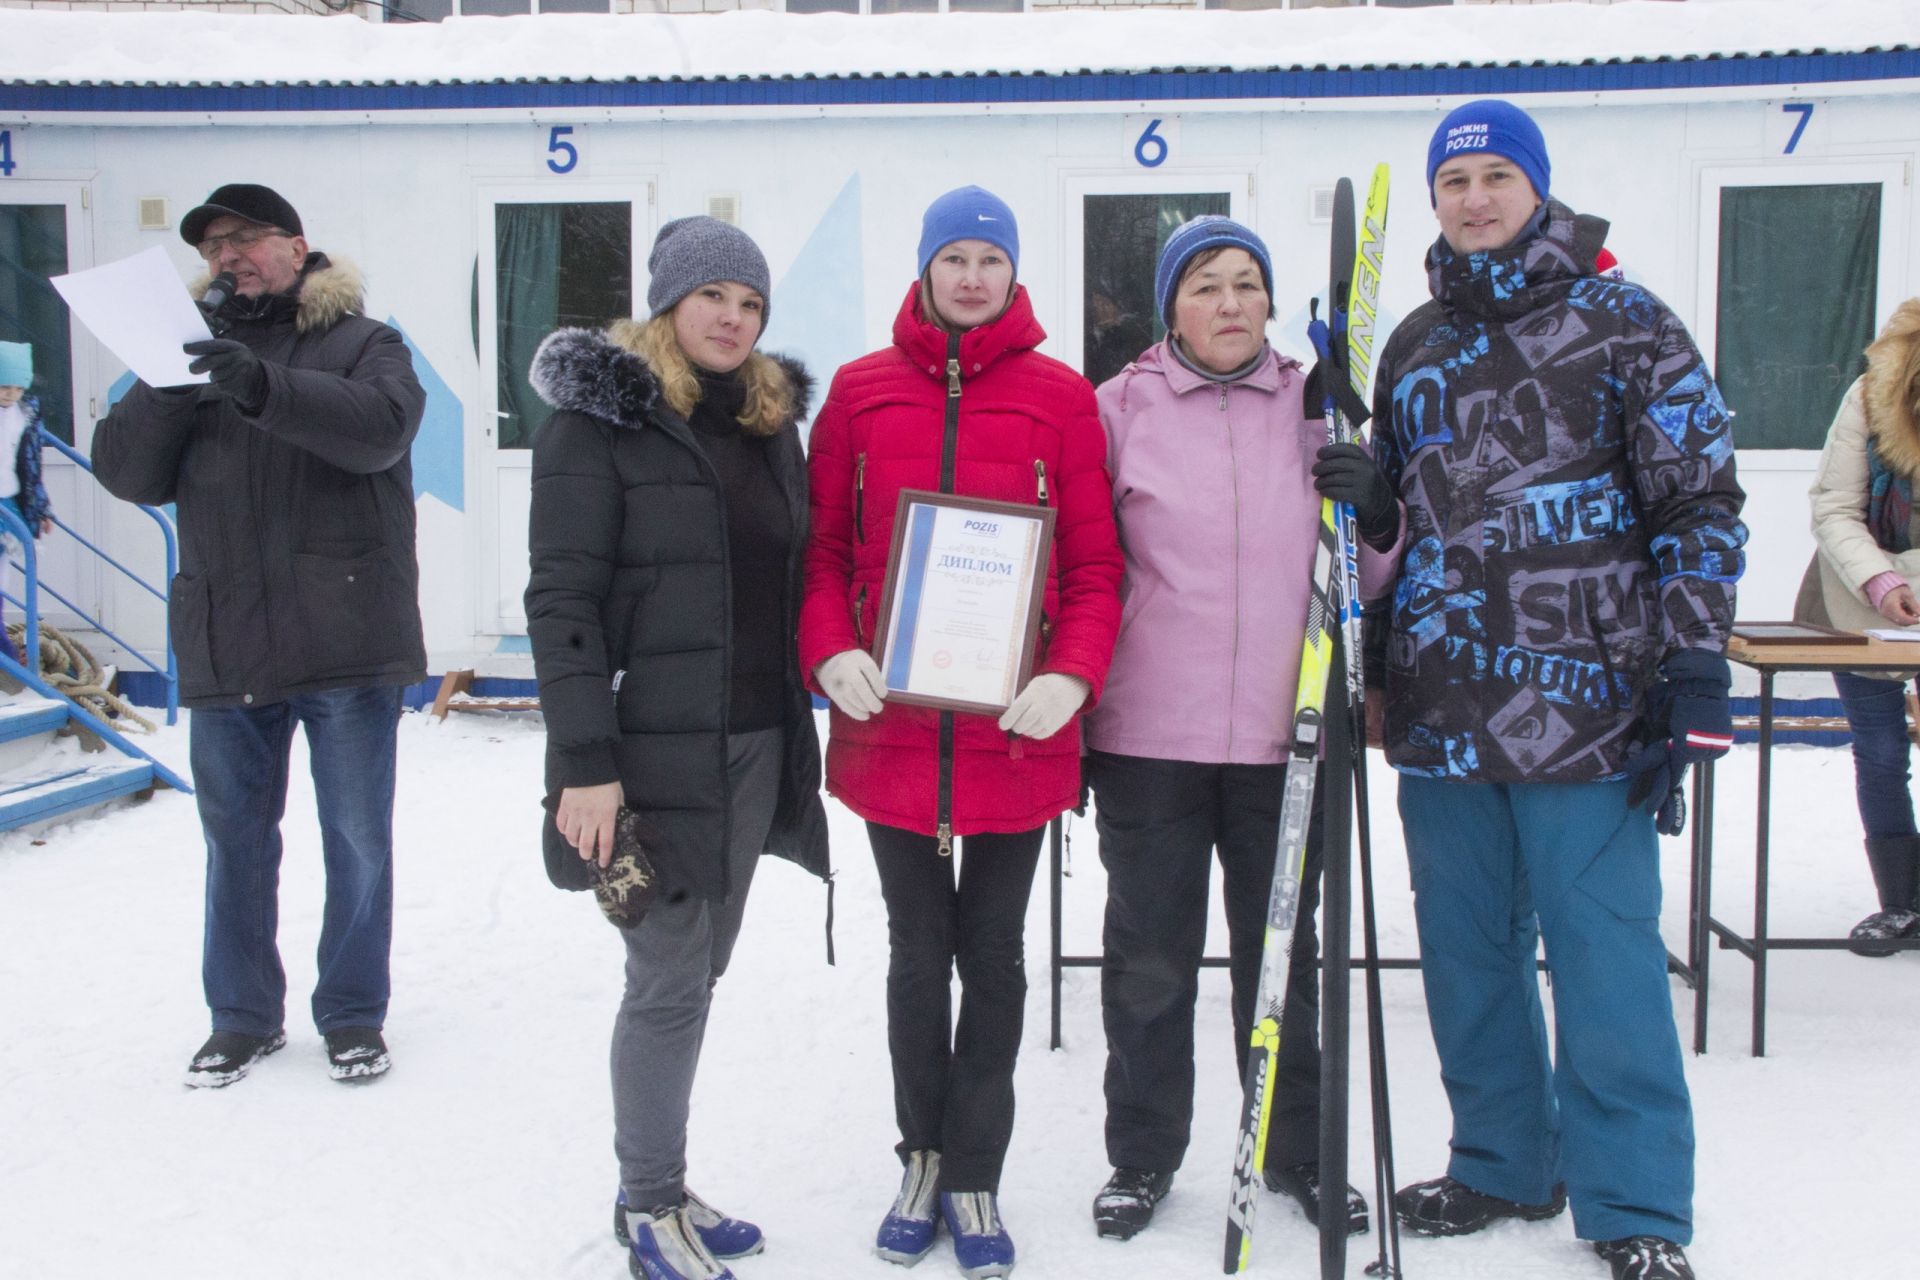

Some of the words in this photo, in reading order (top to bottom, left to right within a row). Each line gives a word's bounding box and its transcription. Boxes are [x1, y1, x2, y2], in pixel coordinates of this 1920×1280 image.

[546, 126, 577, 174] 5
[1134, 119, 1168, 167] 6
[1445, 135, 1488, 154] POZIS
[1782, 103, 1814, 154] 7
[964, 519, 999, 533] POZIS
[937, 554, 1013, 576] ДИПЛОМ
[1228, 1128, 1254, 1231] RS
[1250, 1058, 1267, 1136] skate
